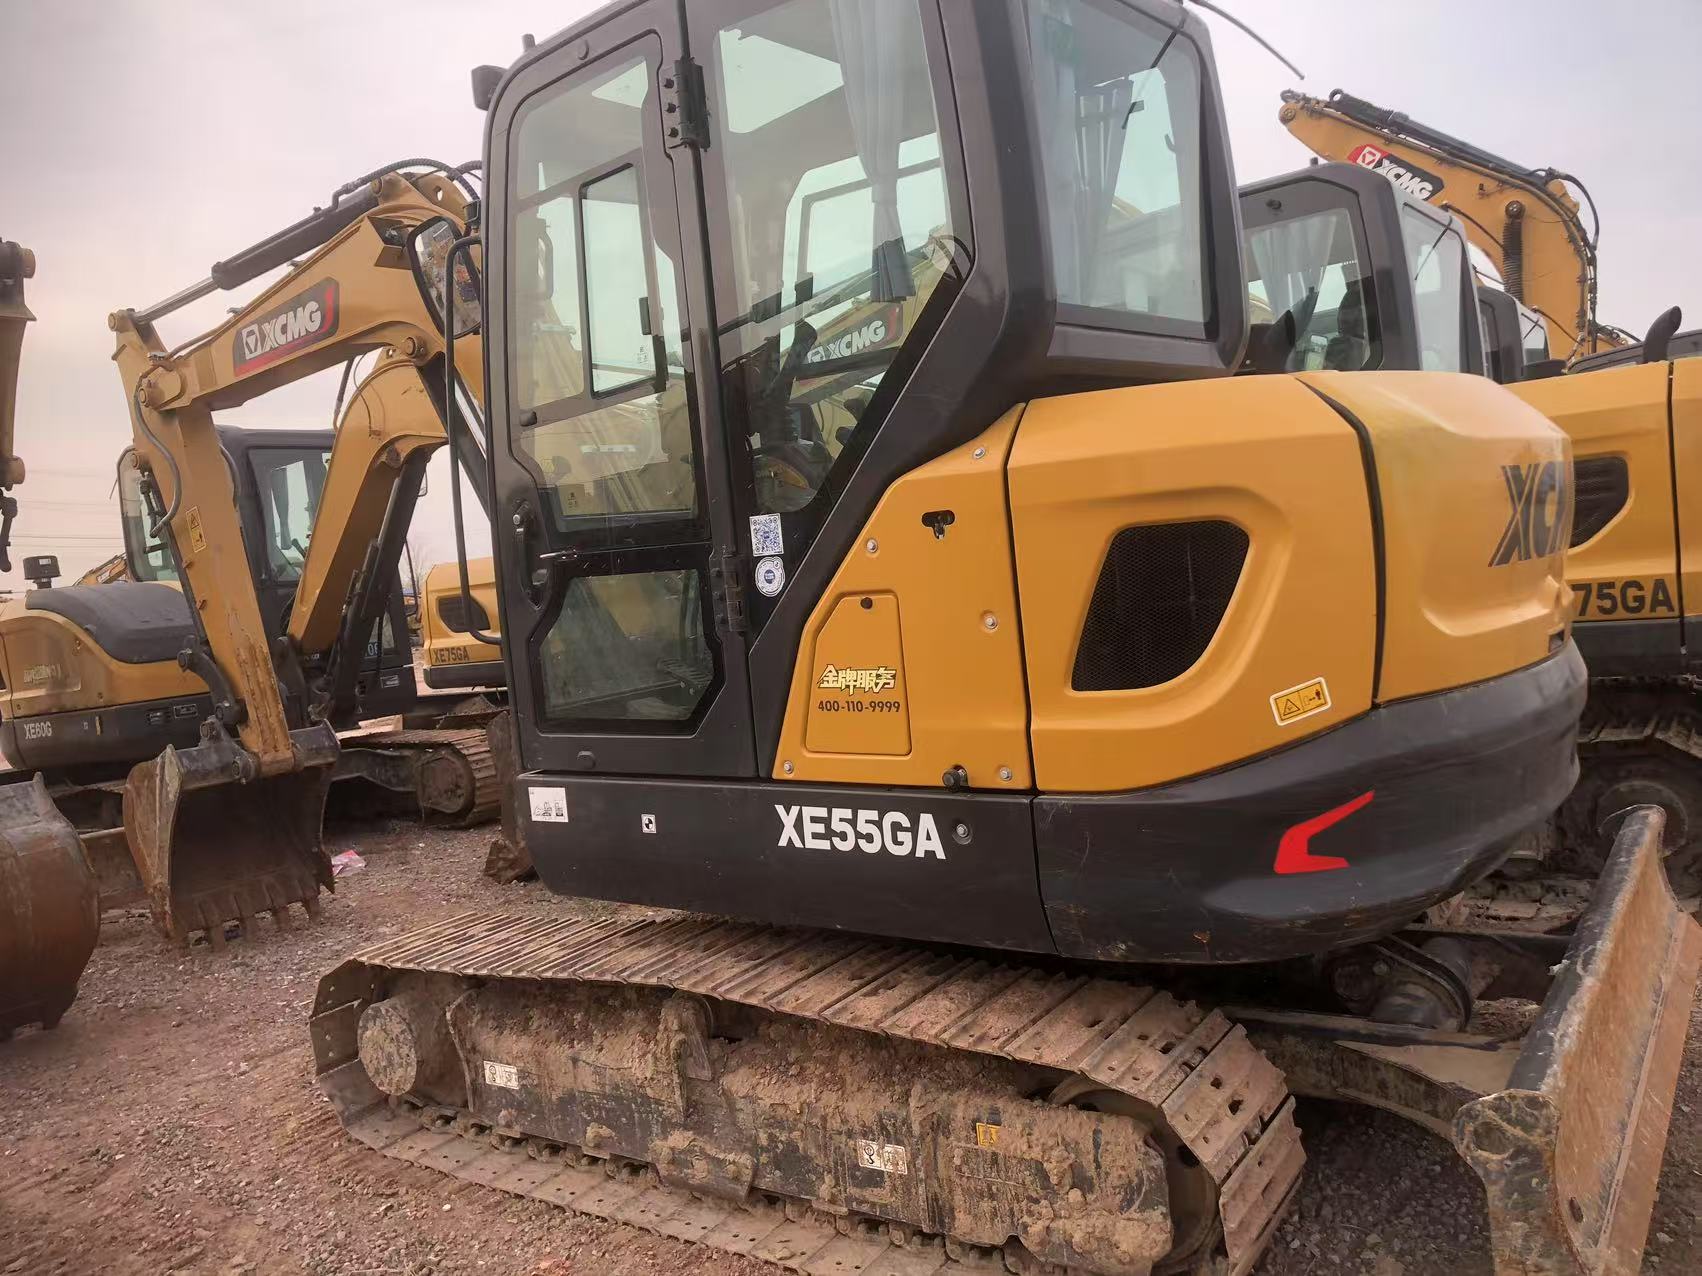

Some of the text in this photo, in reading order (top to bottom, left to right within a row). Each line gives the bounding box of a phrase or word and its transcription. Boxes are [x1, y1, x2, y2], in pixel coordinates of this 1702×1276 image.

[1372, 158, 1433, 200] XCMG
[261, 301, 322, 353] XCMG
[826, 320, 885, 360] XCMG
[1488, 461, 1568, 568] XC
[433, 646, 470, 663] XE75GA
[817, 664, 896, 696] 金牌服务
[818, 700, 901, 713] 400-110-9999
[774, 804, 946, 860] XE55GA
